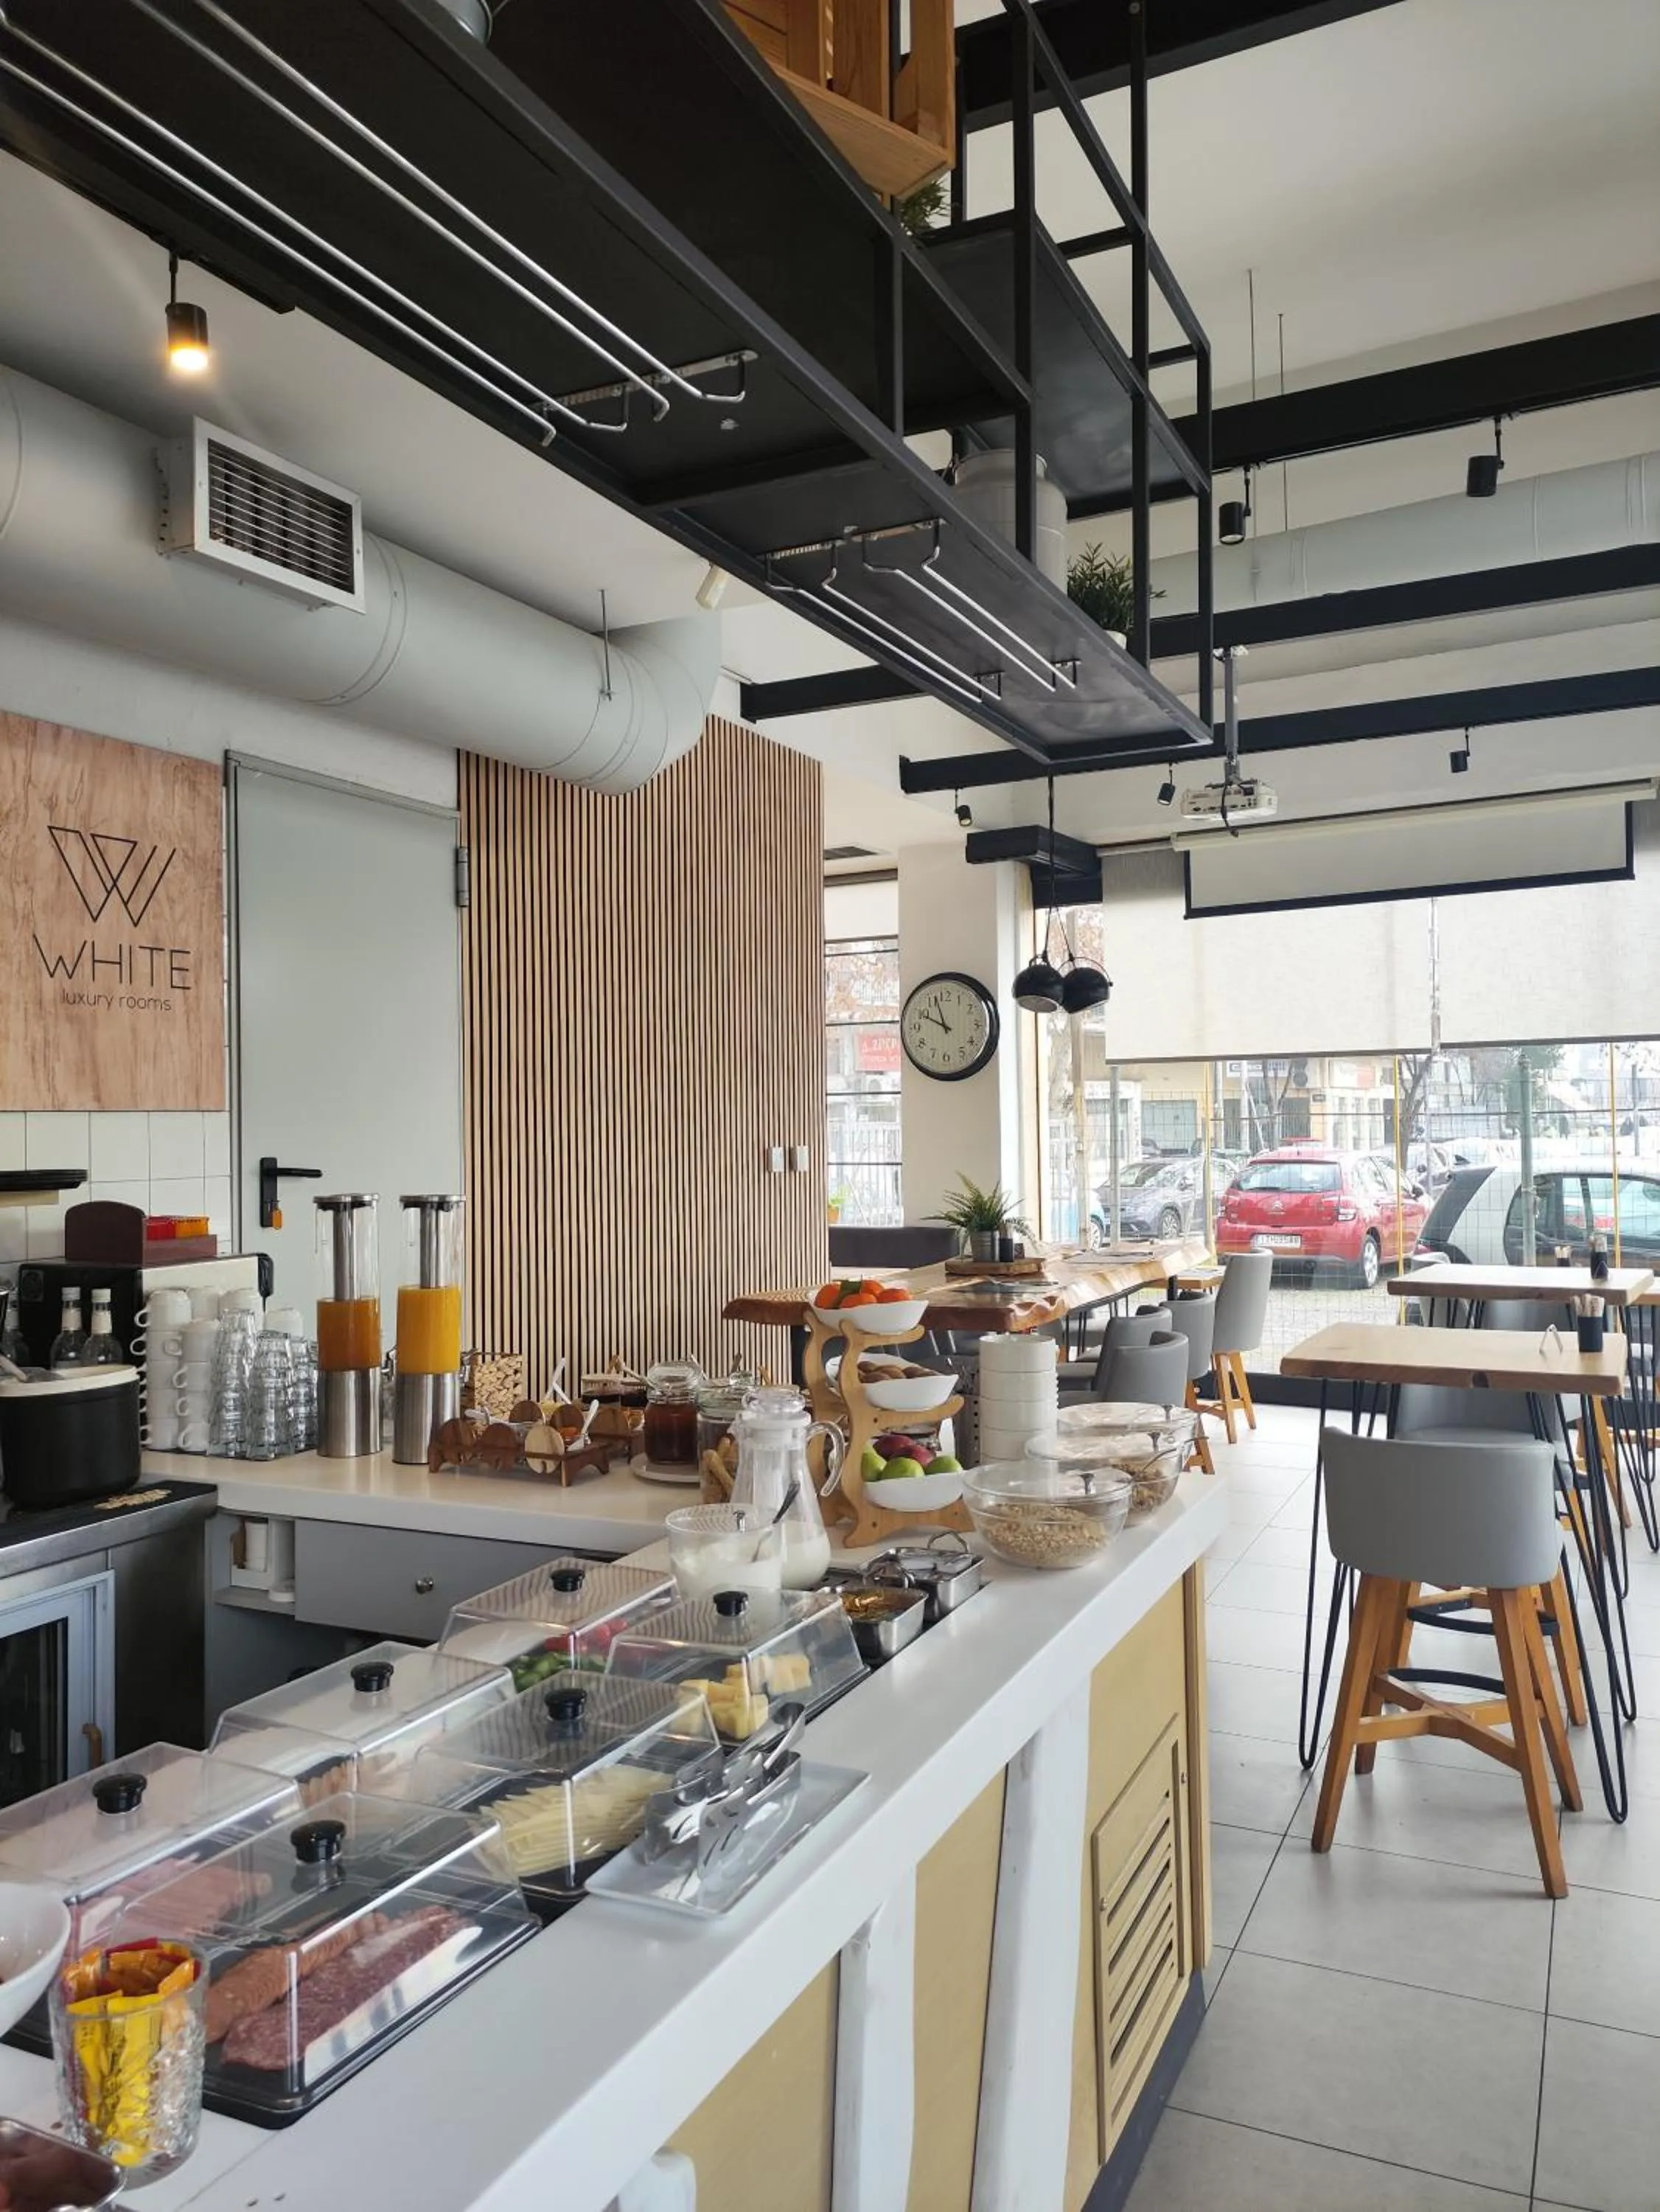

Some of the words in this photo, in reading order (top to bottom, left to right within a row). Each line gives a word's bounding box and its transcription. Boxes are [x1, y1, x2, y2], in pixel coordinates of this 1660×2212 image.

[32, 933, 192, 990] WHITE
[62, 989, 114, 1011] luxury
[119, 995, 172, 1012] rooms
[939, 990, 952, 1002] 12
[913, 1022, 921, 1033] 9
[930, 1048, 937, 1059] 7
[943, 1051, 950, 1062] 6
